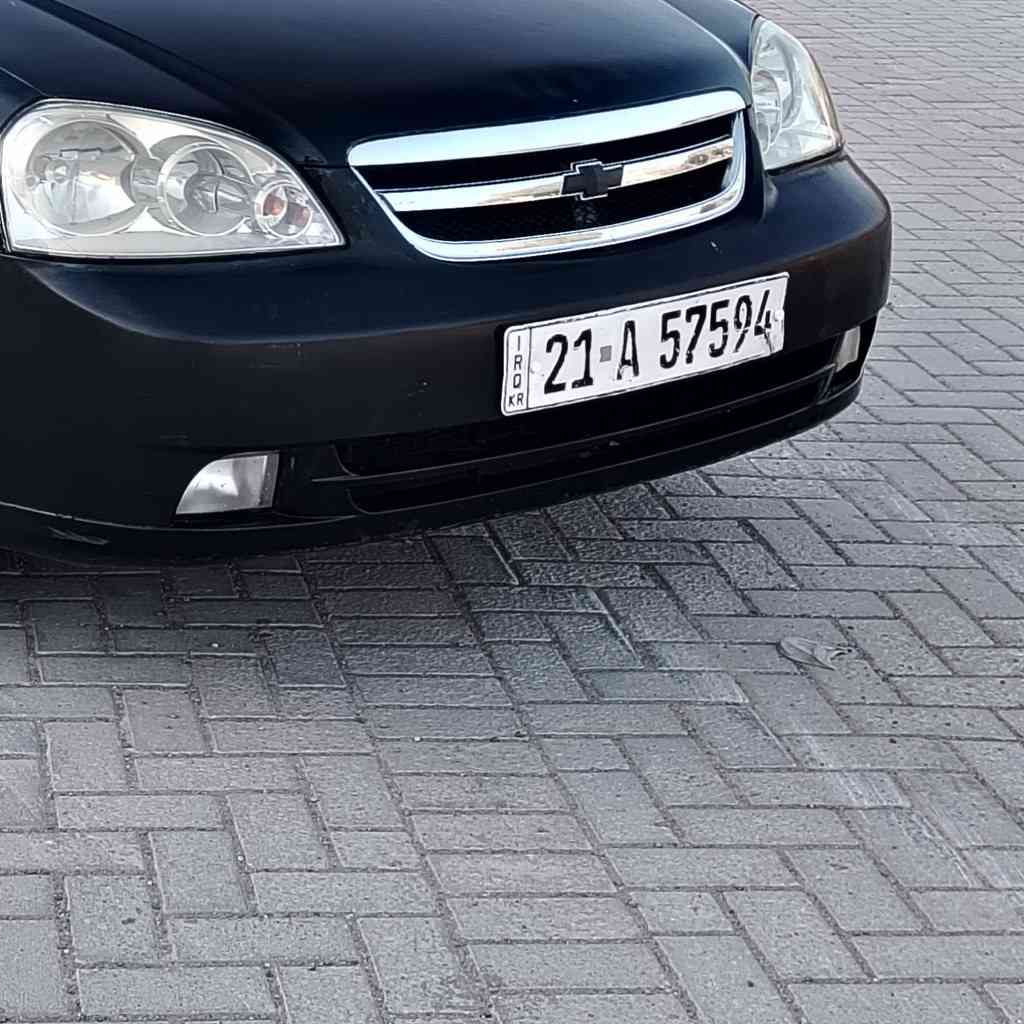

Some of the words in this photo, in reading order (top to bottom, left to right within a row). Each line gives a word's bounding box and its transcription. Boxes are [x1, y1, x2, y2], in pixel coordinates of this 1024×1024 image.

[544, 328, 593, 395] 21
[617, 320, 639, 380] A
[660, 289, 772, 368] 57594
[508, 393, 524, 407] KR
